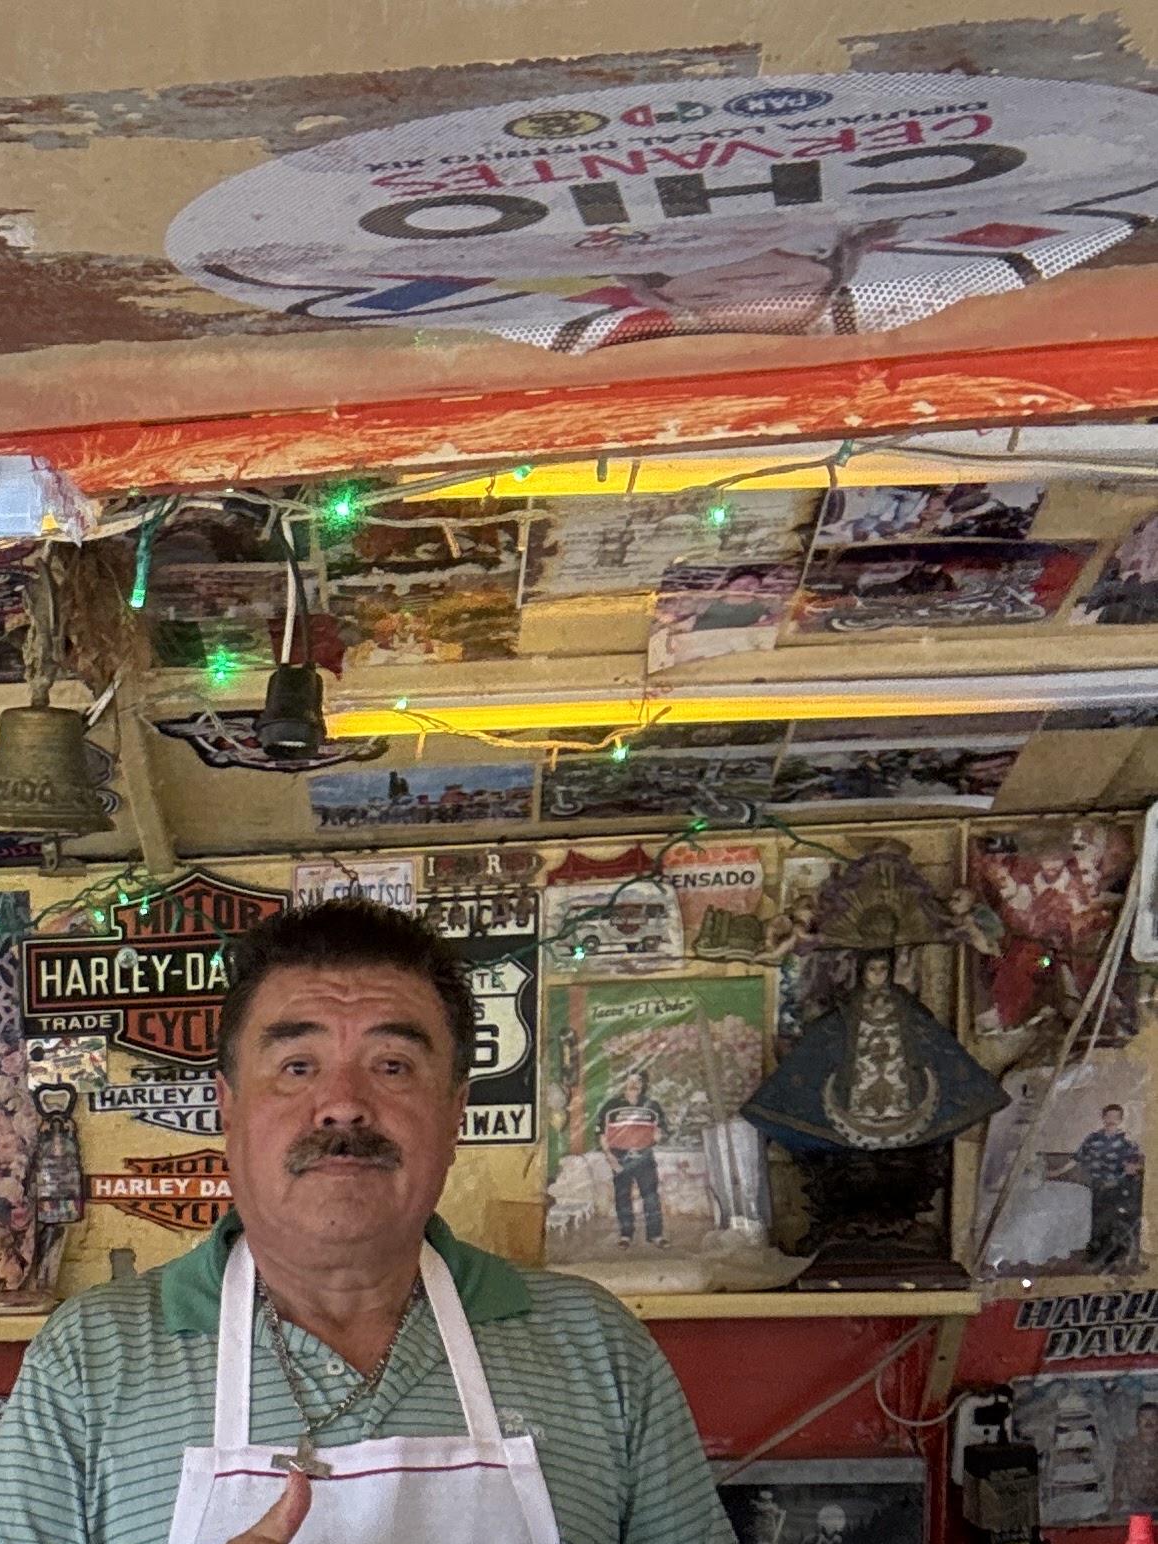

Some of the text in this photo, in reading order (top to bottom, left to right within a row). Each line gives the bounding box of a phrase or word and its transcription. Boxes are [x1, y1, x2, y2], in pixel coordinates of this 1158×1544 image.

[362, 101, 991, 173] DIPUTADA LOCAL DISTRITO XIX
[370, 112, 995, 197] CERVANTES
[358, 143, 1029, 240] CHIO
[136, 886, 264, 936] MOTOR
[40, 953, 231, 997] HARLEY-DA
[39, 1014, 113, 1032] TRADE
[137, 1008, 219, 1050] CYCL
[100, 1086, 194, 1107] HARLEY
[95, 1178, 191, 1196] HARLEY
[1014, 1289, 1158, 1331] HARL
[1044, 1323, 1158, 1361] DAVI
